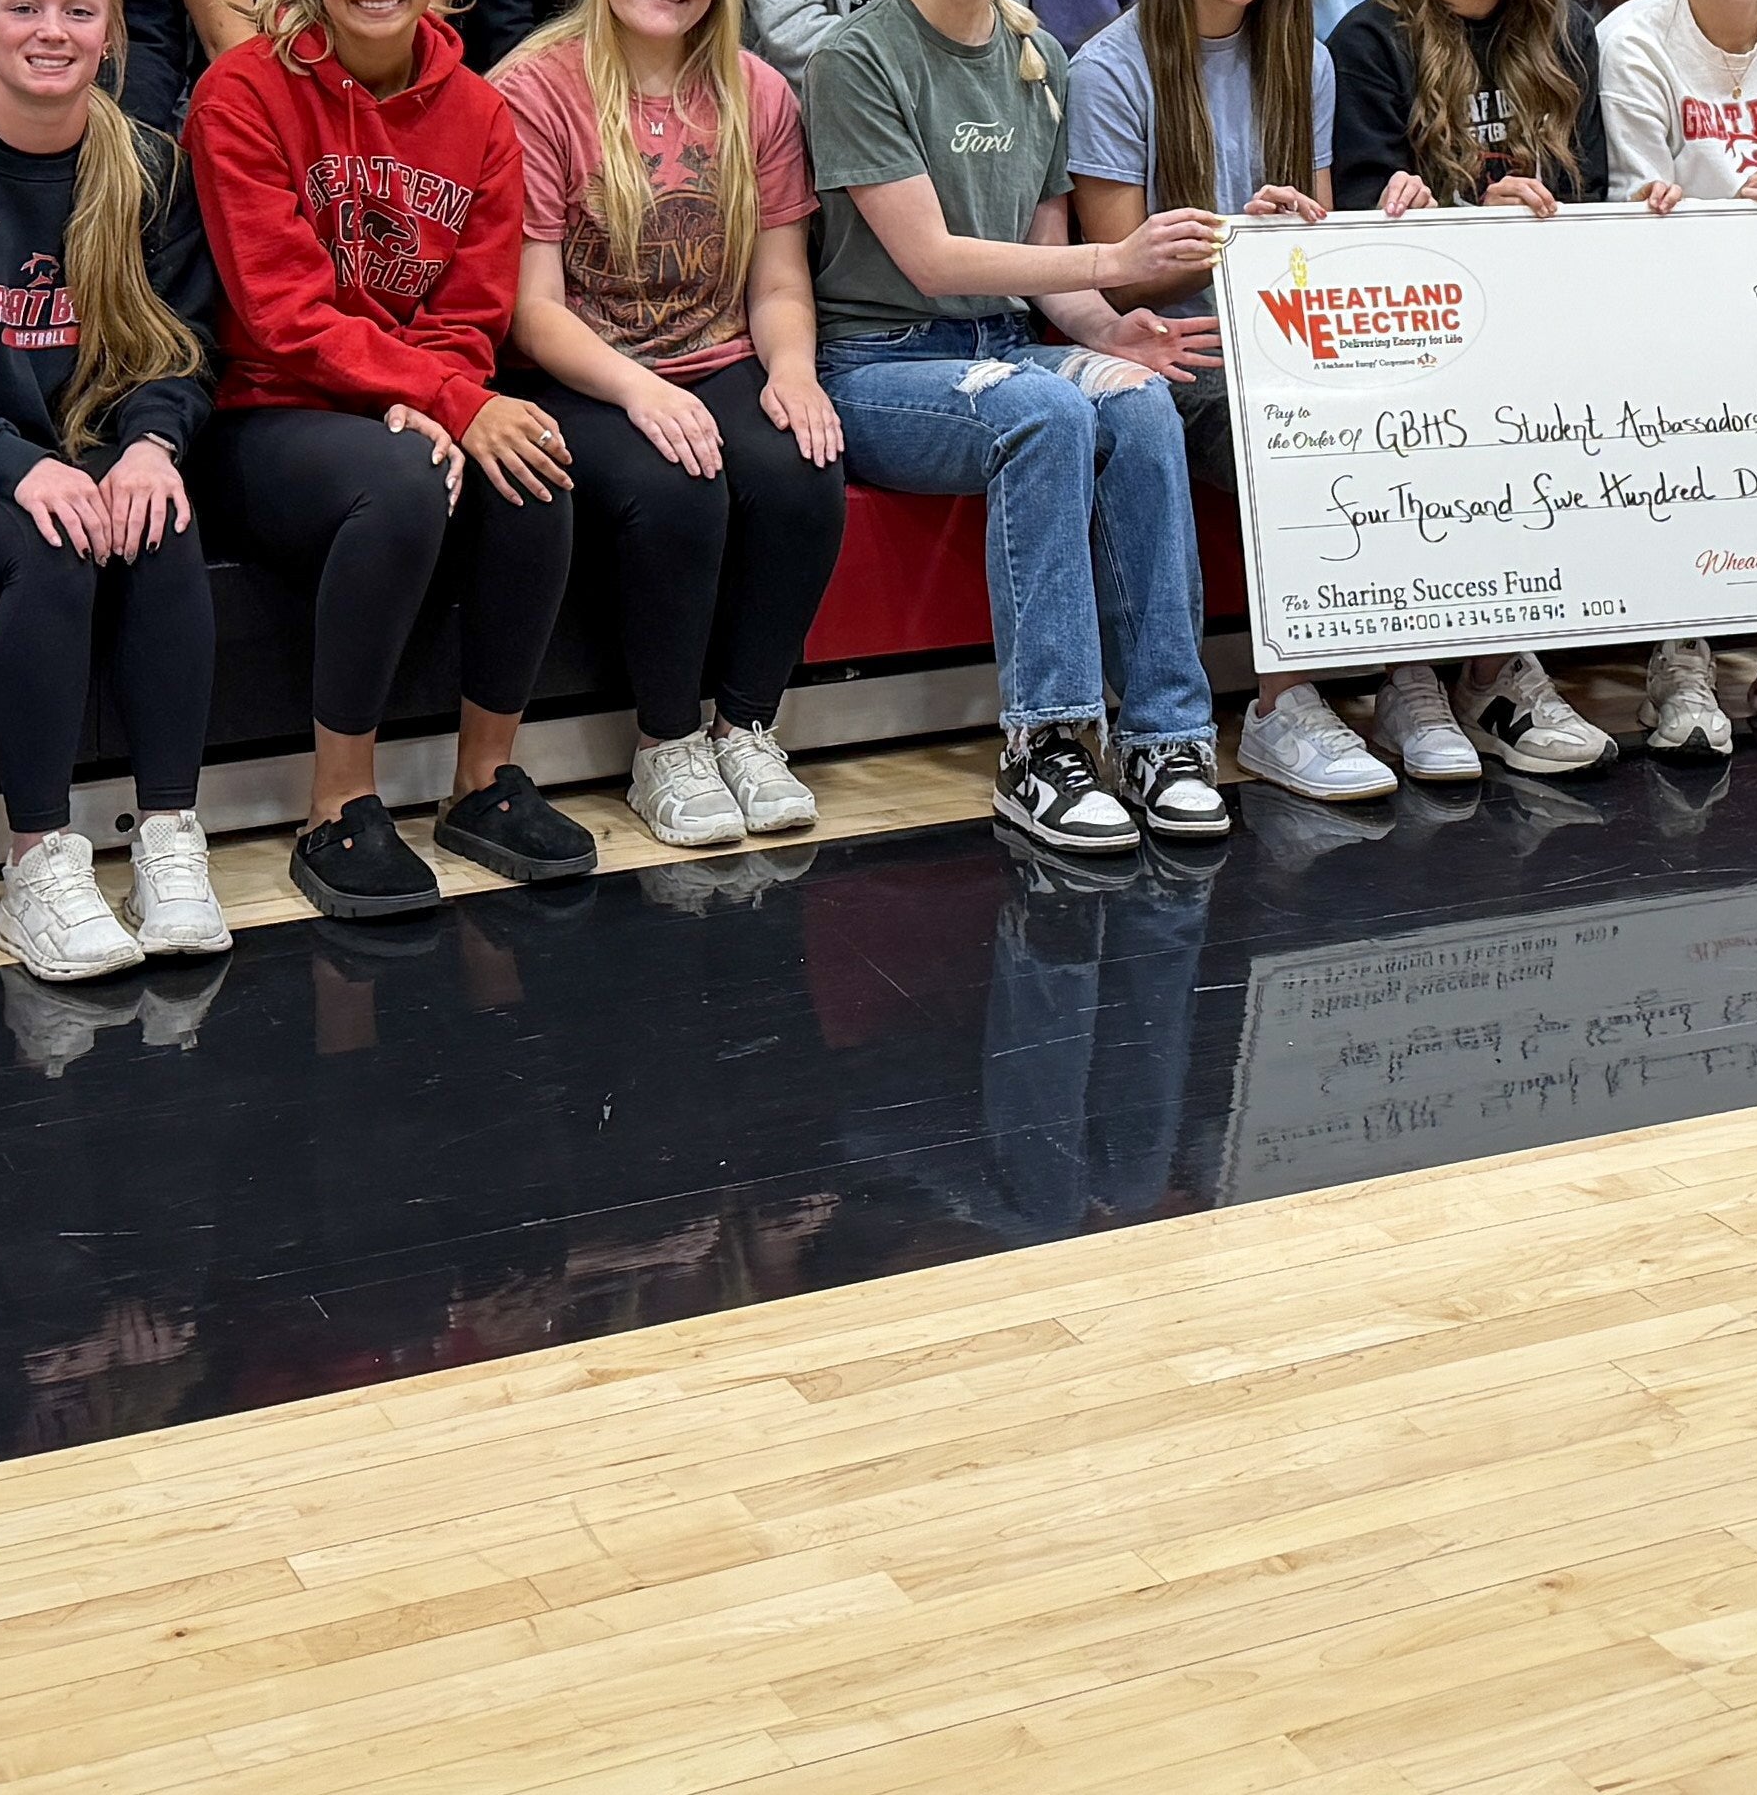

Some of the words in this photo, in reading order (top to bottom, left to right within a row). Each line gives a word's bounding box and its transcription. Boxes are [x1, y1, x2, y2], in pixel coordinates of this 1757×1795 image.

[950, 121, 1015, 155] Ford
[1257, 283, 1463, 347] WHEATLAND
[1308, 308, 1460, 360] ELECTRIC
[1264, 404, 1293, 427] Pay
[1375, 408, 1468, 458] GBHS
[1495, 403, 1603, 456] Student
[1267, 432, 1290, 450] the
[1293, 430, 1335, 449] Order
[1339, 428, 1363, 452] Of
[1388, 481, 1514, 543] Thousand
[1600, 466, 1718, 523] Hundred
[1282, 593, 1311, 612] For
[1317, 581, 1407, 611] Sharing
[1413, 577, 1498, 603] Success
[1504, 567, 1562, 595] Fund
